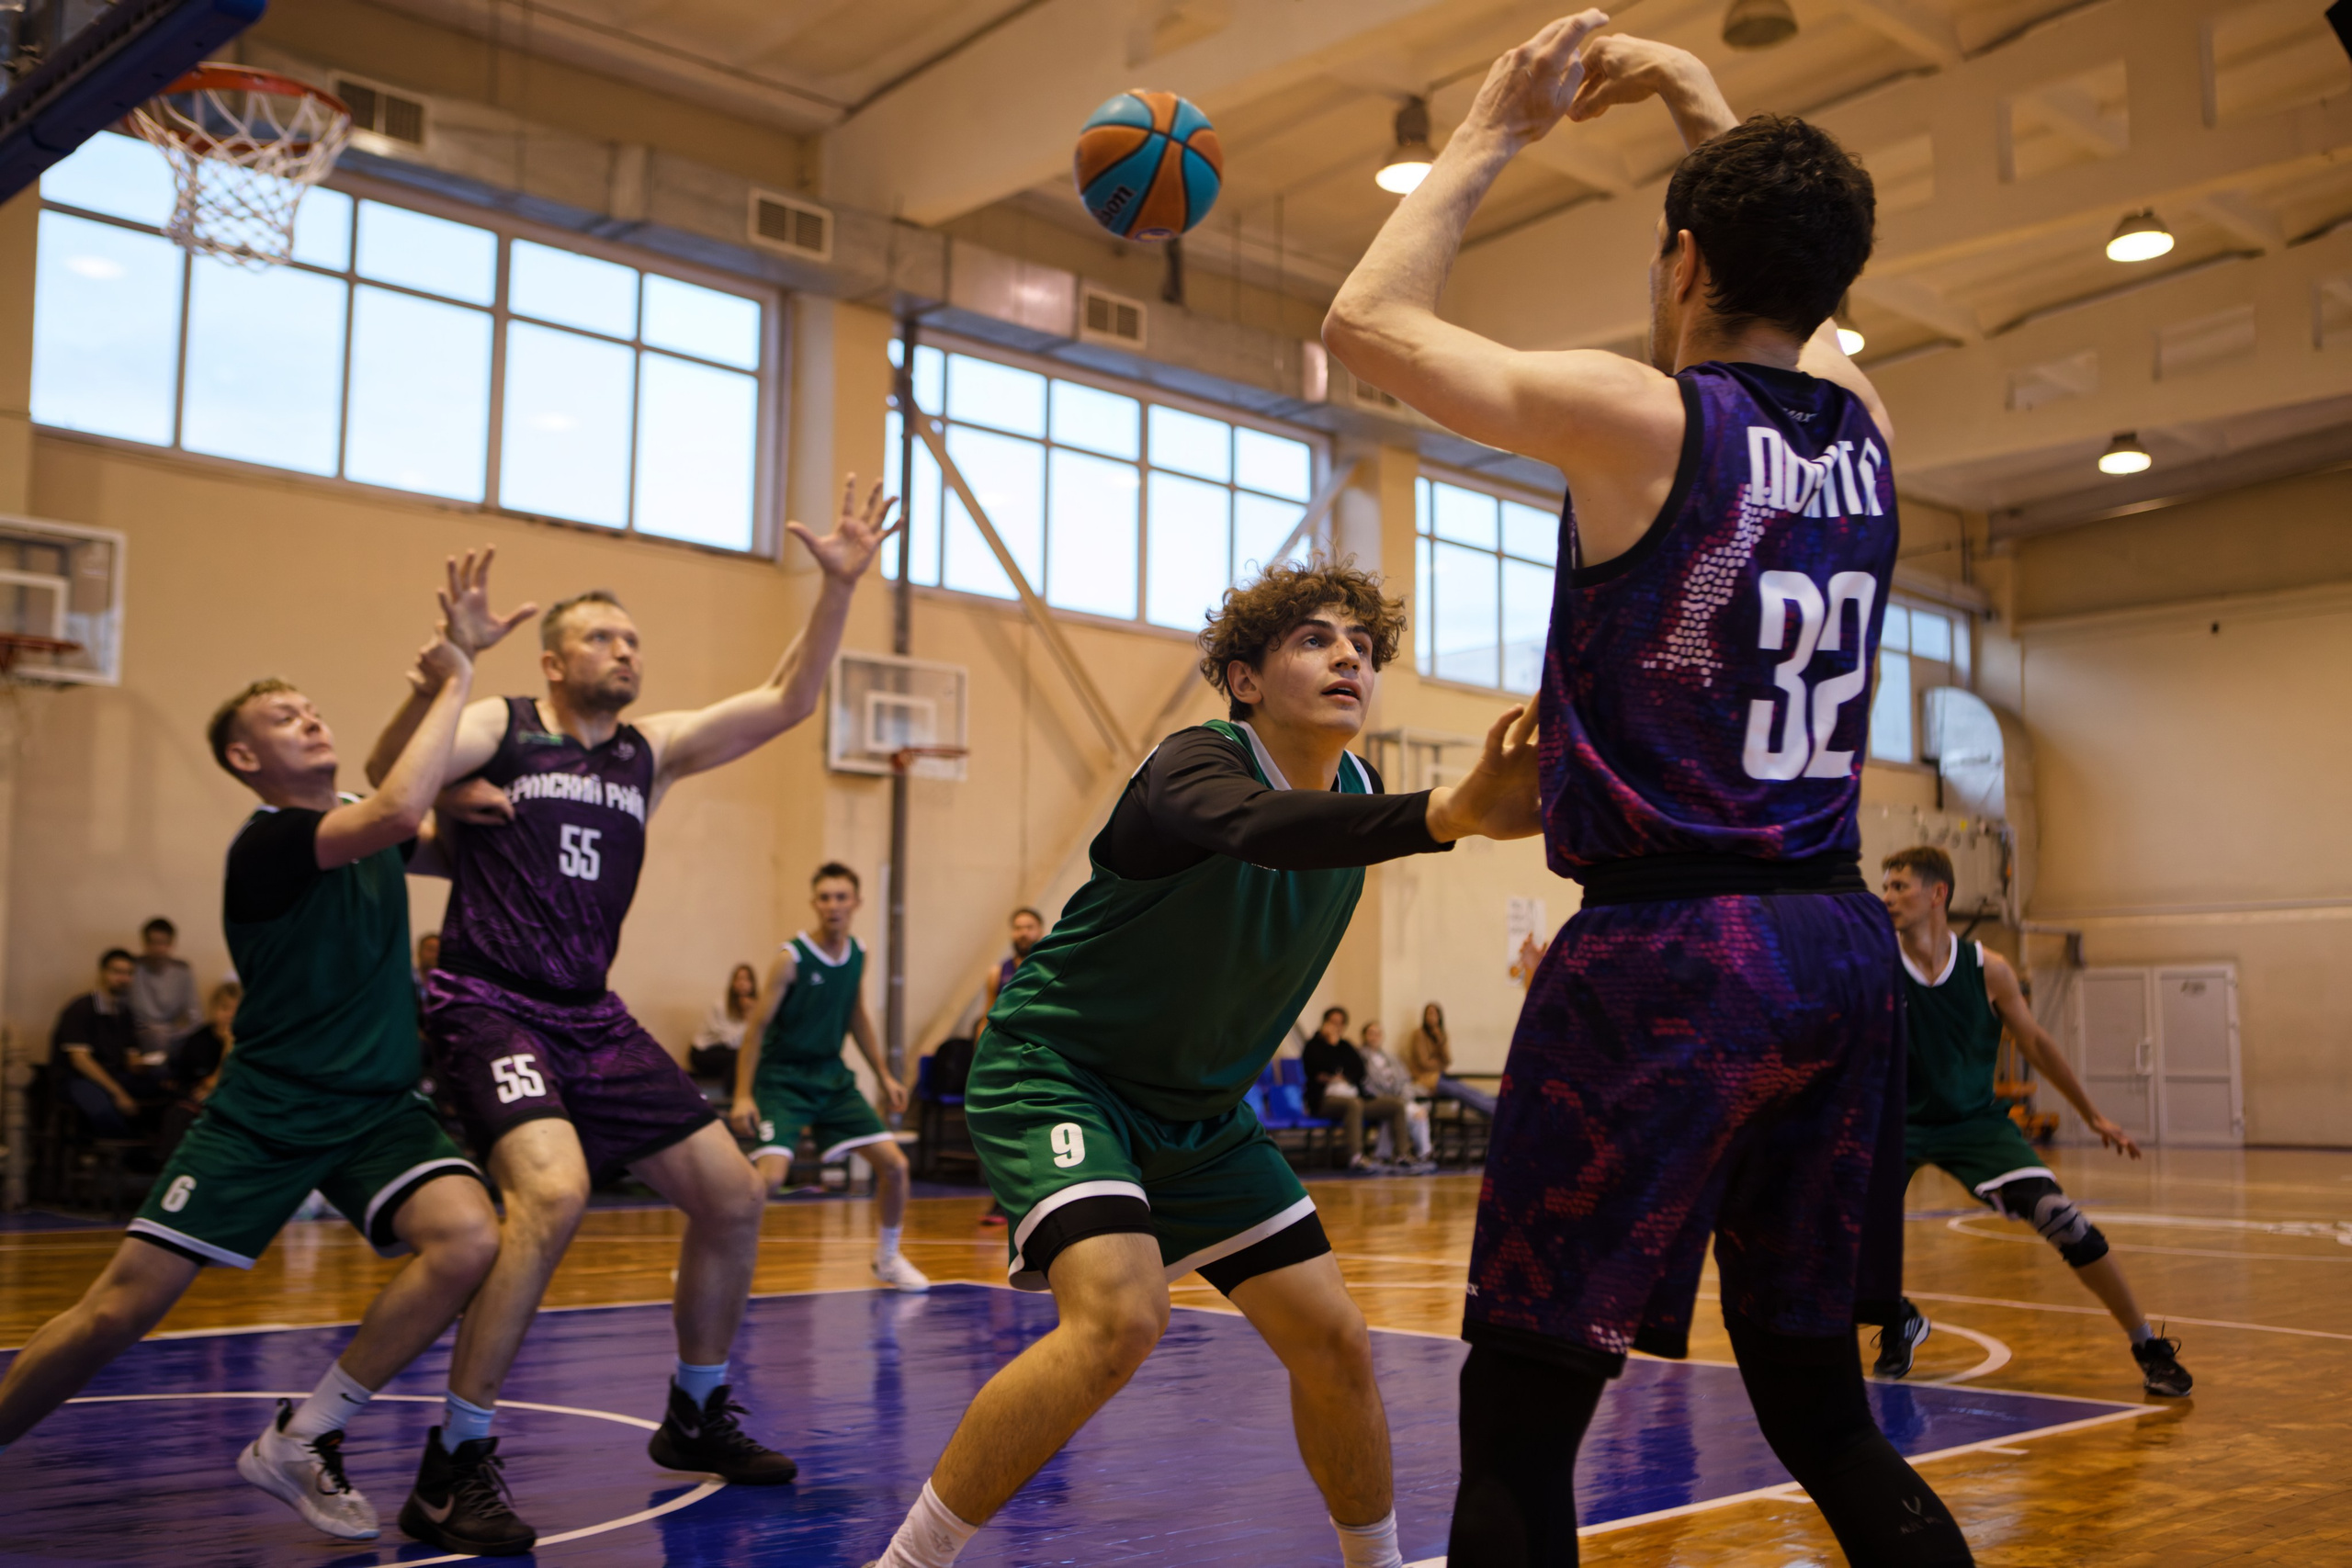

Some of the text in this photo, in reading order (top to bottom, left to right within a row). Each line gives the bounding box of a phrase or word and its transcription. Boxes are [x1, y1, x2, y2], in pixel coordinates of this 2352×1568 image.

[1743, 570, 1876, 780] 32
[560, 823, 602, 881] 55
[490, 1054, 547, 1104] 55
[1050, 1122, 1086, 1168] 9
[160, 1175, 198, 1213] 6
